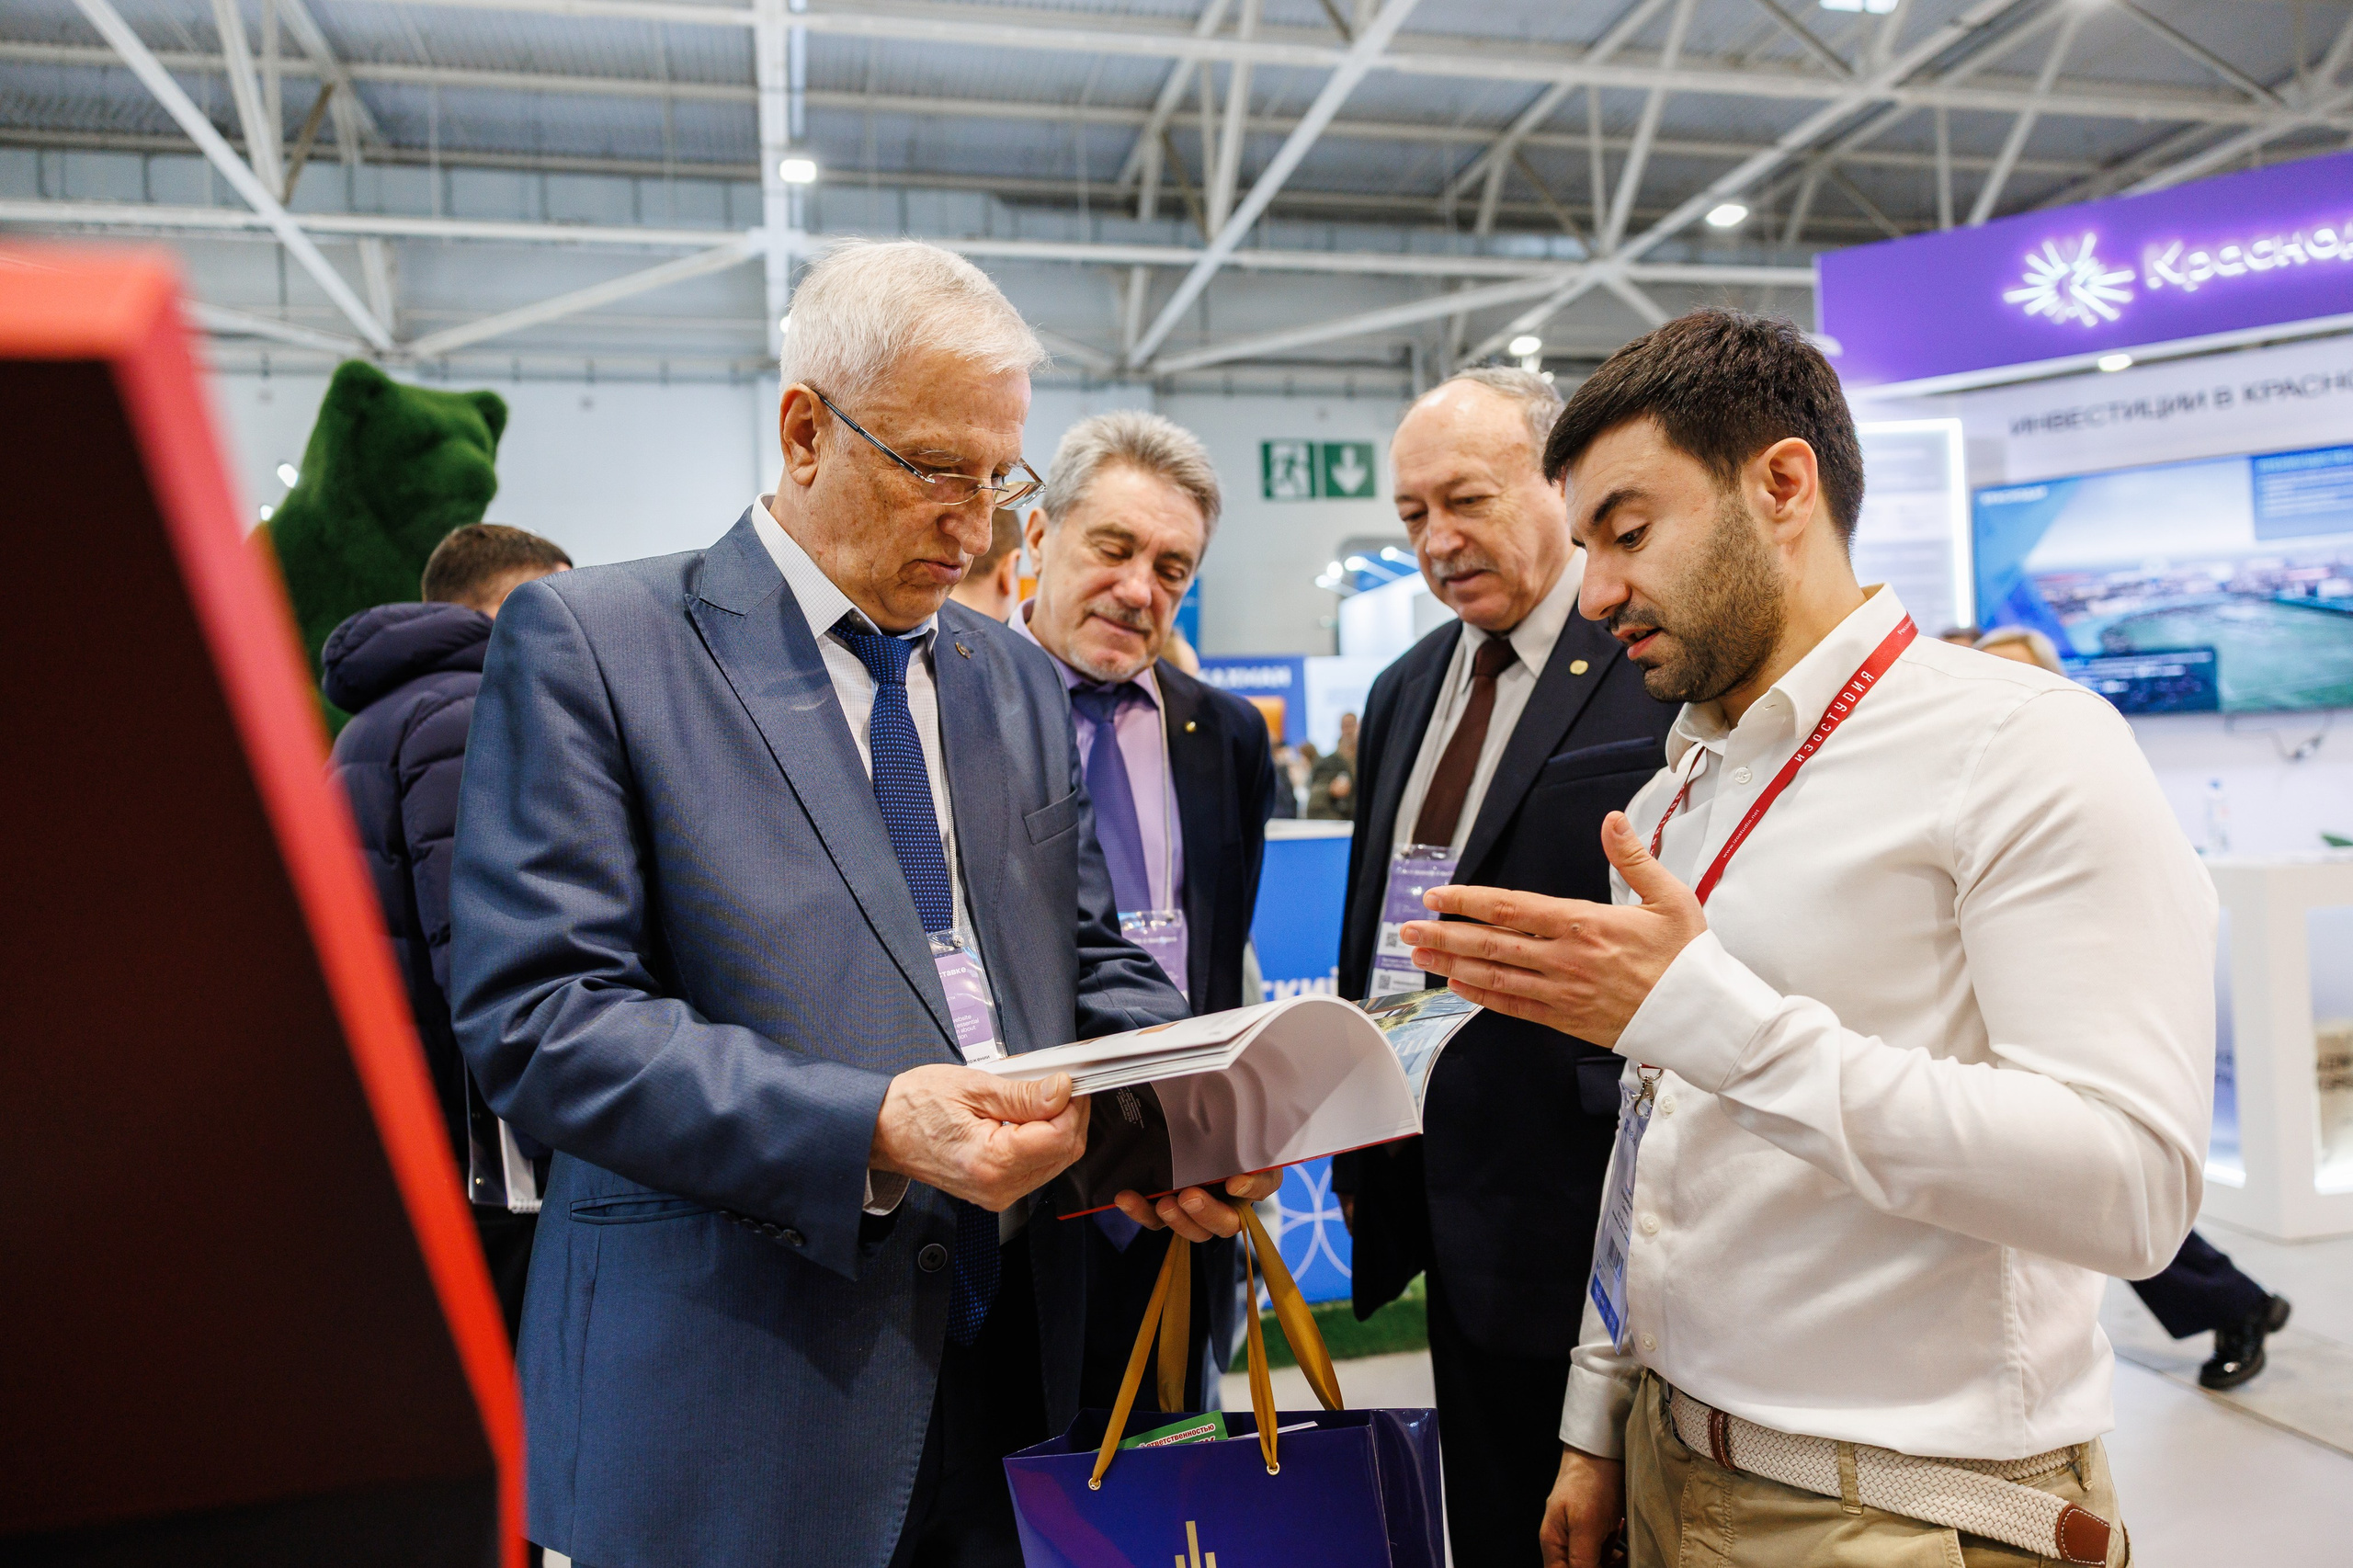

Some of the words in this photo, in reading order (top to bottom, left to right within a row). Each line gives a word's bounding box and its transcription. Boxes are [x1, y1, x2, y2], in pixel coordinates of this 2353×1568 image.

[2010, 392, 2205, 436] ИНВЕСТИЦИИ
[2213, 386, 2234, 410] В
[1722, 809, 1760, 858] www.izostudia.net
[957, 1018, 980, 1028] essential
[961, 1025, 977, 1033] about
[1145, 1424, 1215, 1448] ответственностью
